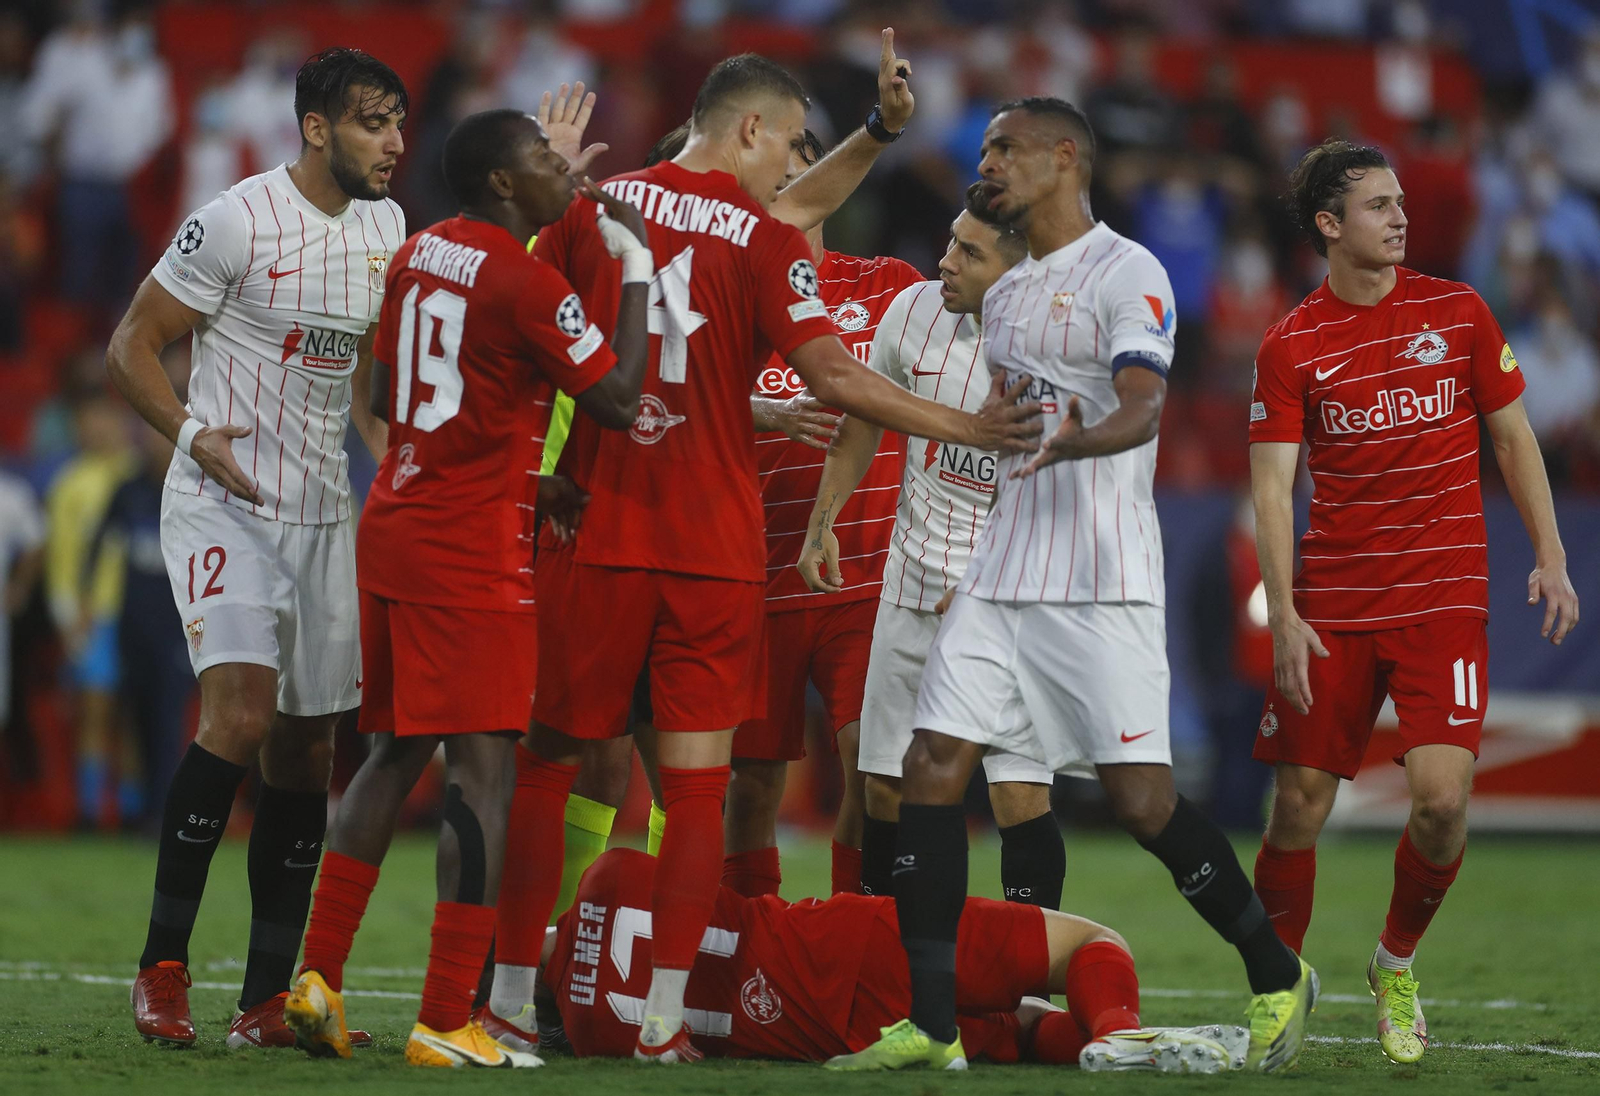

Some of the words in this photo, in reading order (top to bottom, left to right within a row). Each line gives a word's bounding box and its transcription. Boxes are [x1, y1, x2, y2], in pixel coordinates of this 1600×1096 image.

[408, 233, 489, 288] CAMARA
[647, 244, 709, 384] 4
[305, 358, 318, 366] Your
[396, 281, 468, 433] 19
[940, 442, 996, 482] NAG
[941, 472, 955, 481] Your
[954, 477, 979, 490] Investing
[980, 485, 994, 493] Supe
[187, 545, 227, 605] 12
[1453, 657, 1478, 711] 11
[187, 813, 219, 828] SFC
